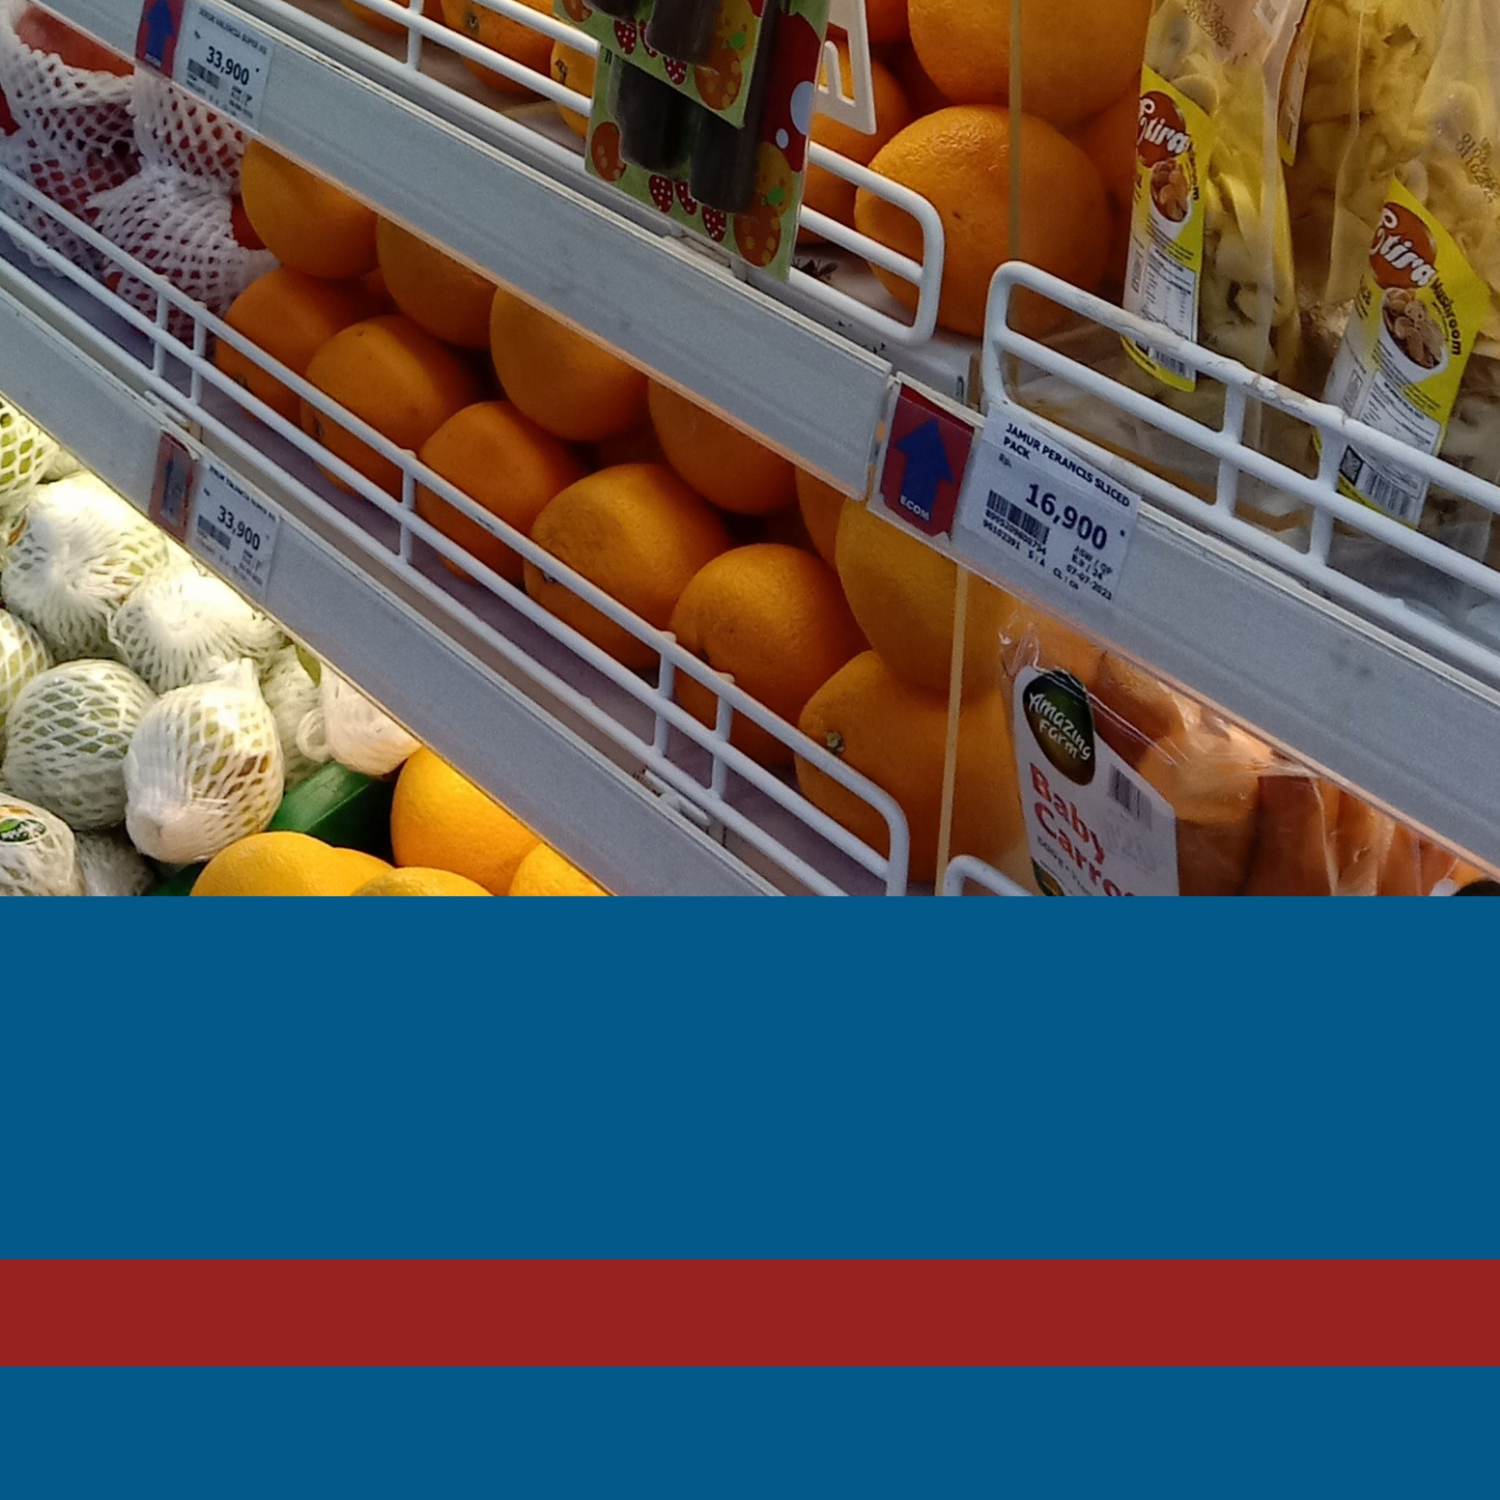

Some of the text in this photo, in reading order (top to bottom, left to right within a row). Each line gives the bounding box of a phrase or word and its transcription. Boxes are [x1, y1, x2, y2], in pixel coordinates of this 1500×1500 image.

[206, 45, 250, 86] 33,900
[1003, 436, 1030, 460] PACK
[1005, 422, 1131, 508] JAMUR PERANCIS SLICED
[217, 504, 261, 551] 33,900
[900, 495, 931, 522] ECOM
[1025, 483, 1108, 551] 16,900
[1030, 762, 1106, 866] Baby
[1034, 801, 1136, 897] Carro
